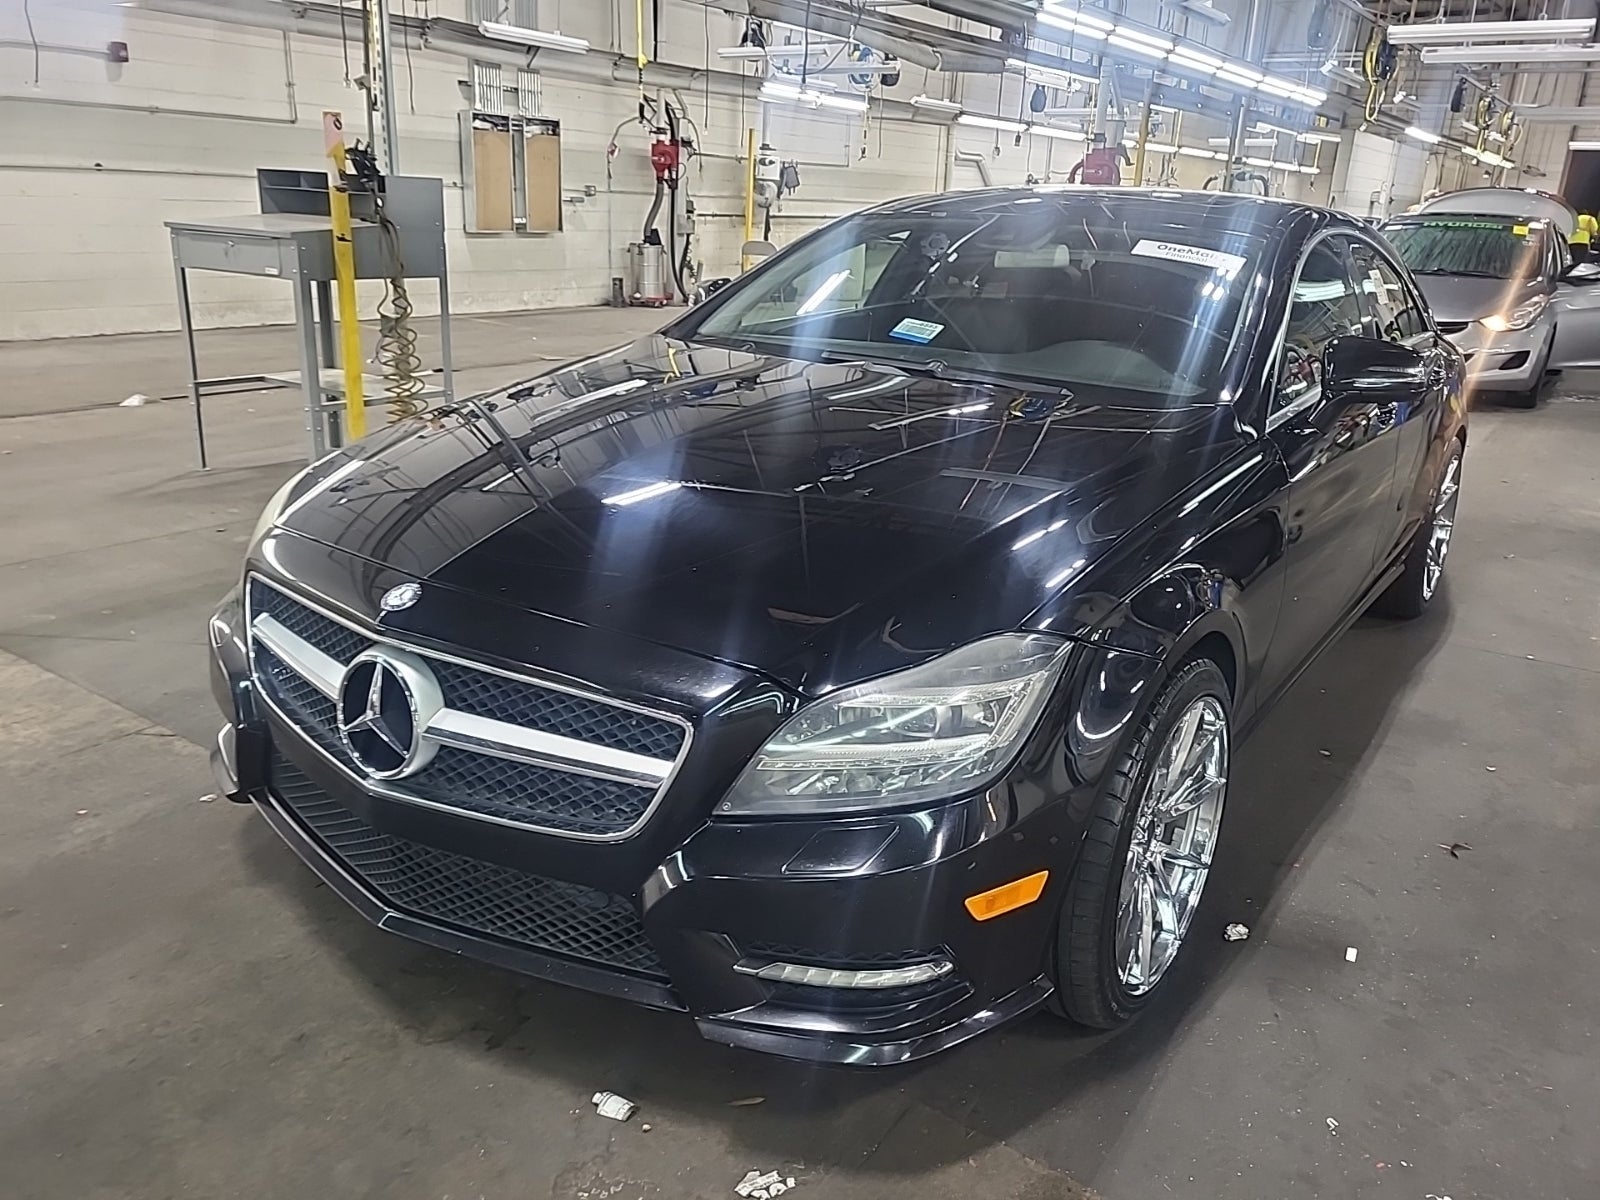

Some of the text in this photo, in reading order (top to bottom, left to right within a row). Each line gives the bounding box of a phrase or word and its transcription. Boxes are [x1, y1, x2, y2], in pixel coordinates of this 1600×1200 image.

[1423, 221, 1502, 229] HYUNDAI
[1157, 244, 1216, 259] OneMai
[1165, 251, 1208, 263] Financial
